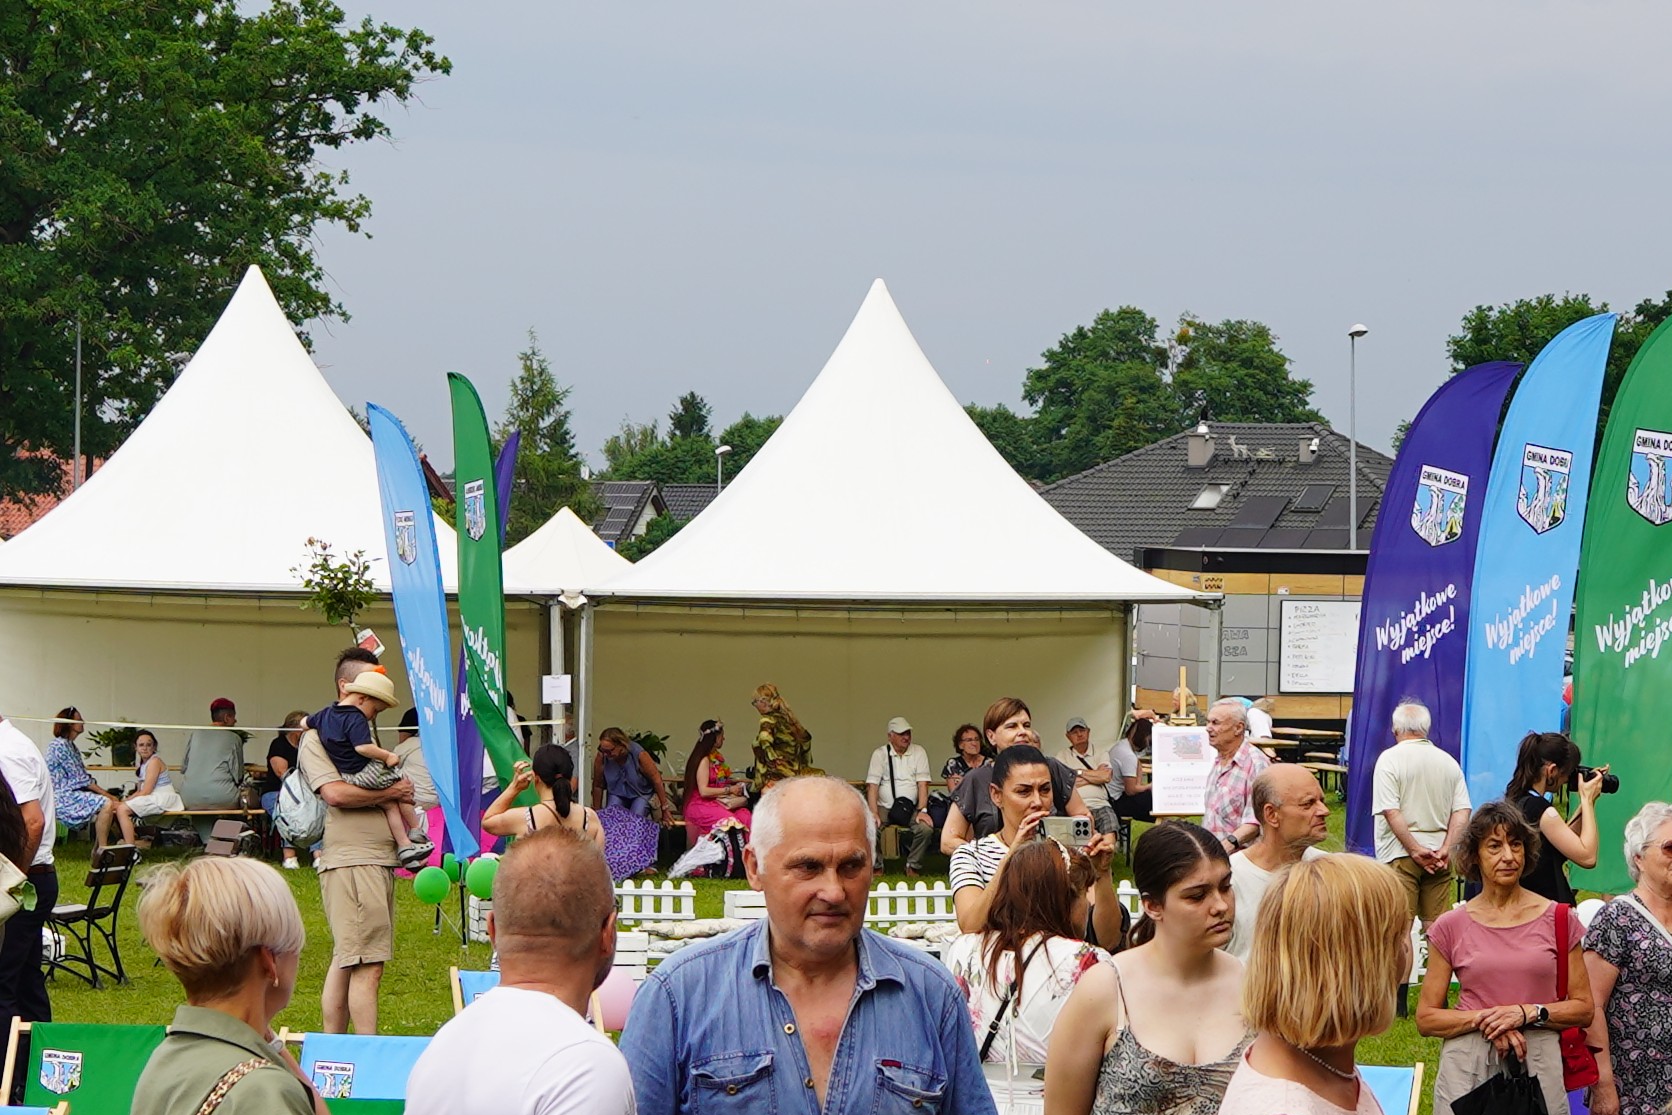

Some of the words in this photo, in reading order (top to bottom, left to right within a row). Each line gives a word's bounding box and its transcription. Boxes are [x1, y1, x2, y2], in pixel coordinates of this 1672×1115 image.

[1526, 451, 1548, 464] GMINA
[1636, 434, 1661, 449] GMINA
[1422, 470, 1442, 483] GMINA
[1443, 475, 1466, 490] DOBRA
[1375, 583, 1457, 650] Wyjątkowe
[1485, 573, 1562, 649] Wyjątkowe
[1222, 630, 1250, 641] AWA
[1401, 605, 1455, 665] miejsce!
[1509, 598, 1558, 665] miejsce!
